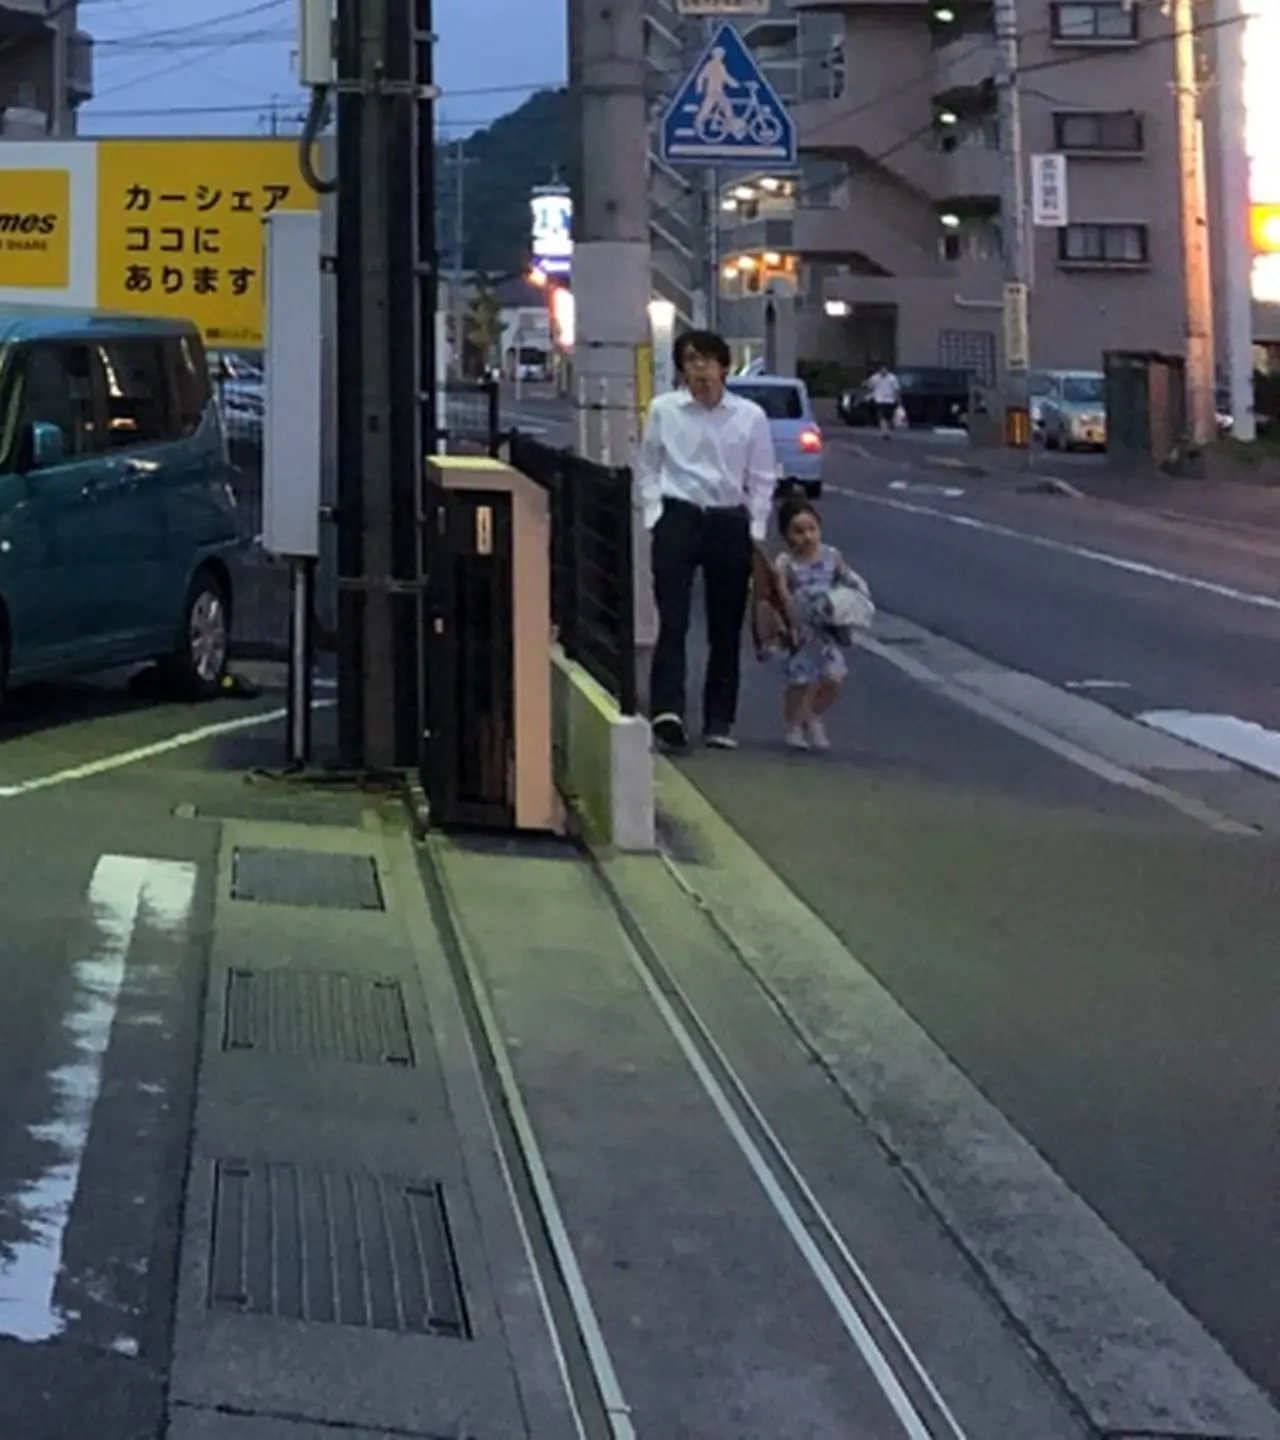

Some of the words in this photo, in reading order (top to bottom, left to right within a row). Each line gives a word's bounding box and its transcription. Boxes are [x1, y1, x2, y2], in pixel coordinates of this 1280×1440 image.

[125, 182, 291, 212] カーシェア
[125, 226, 221, 254] ココに
[124, 264, 256, 296] あります
